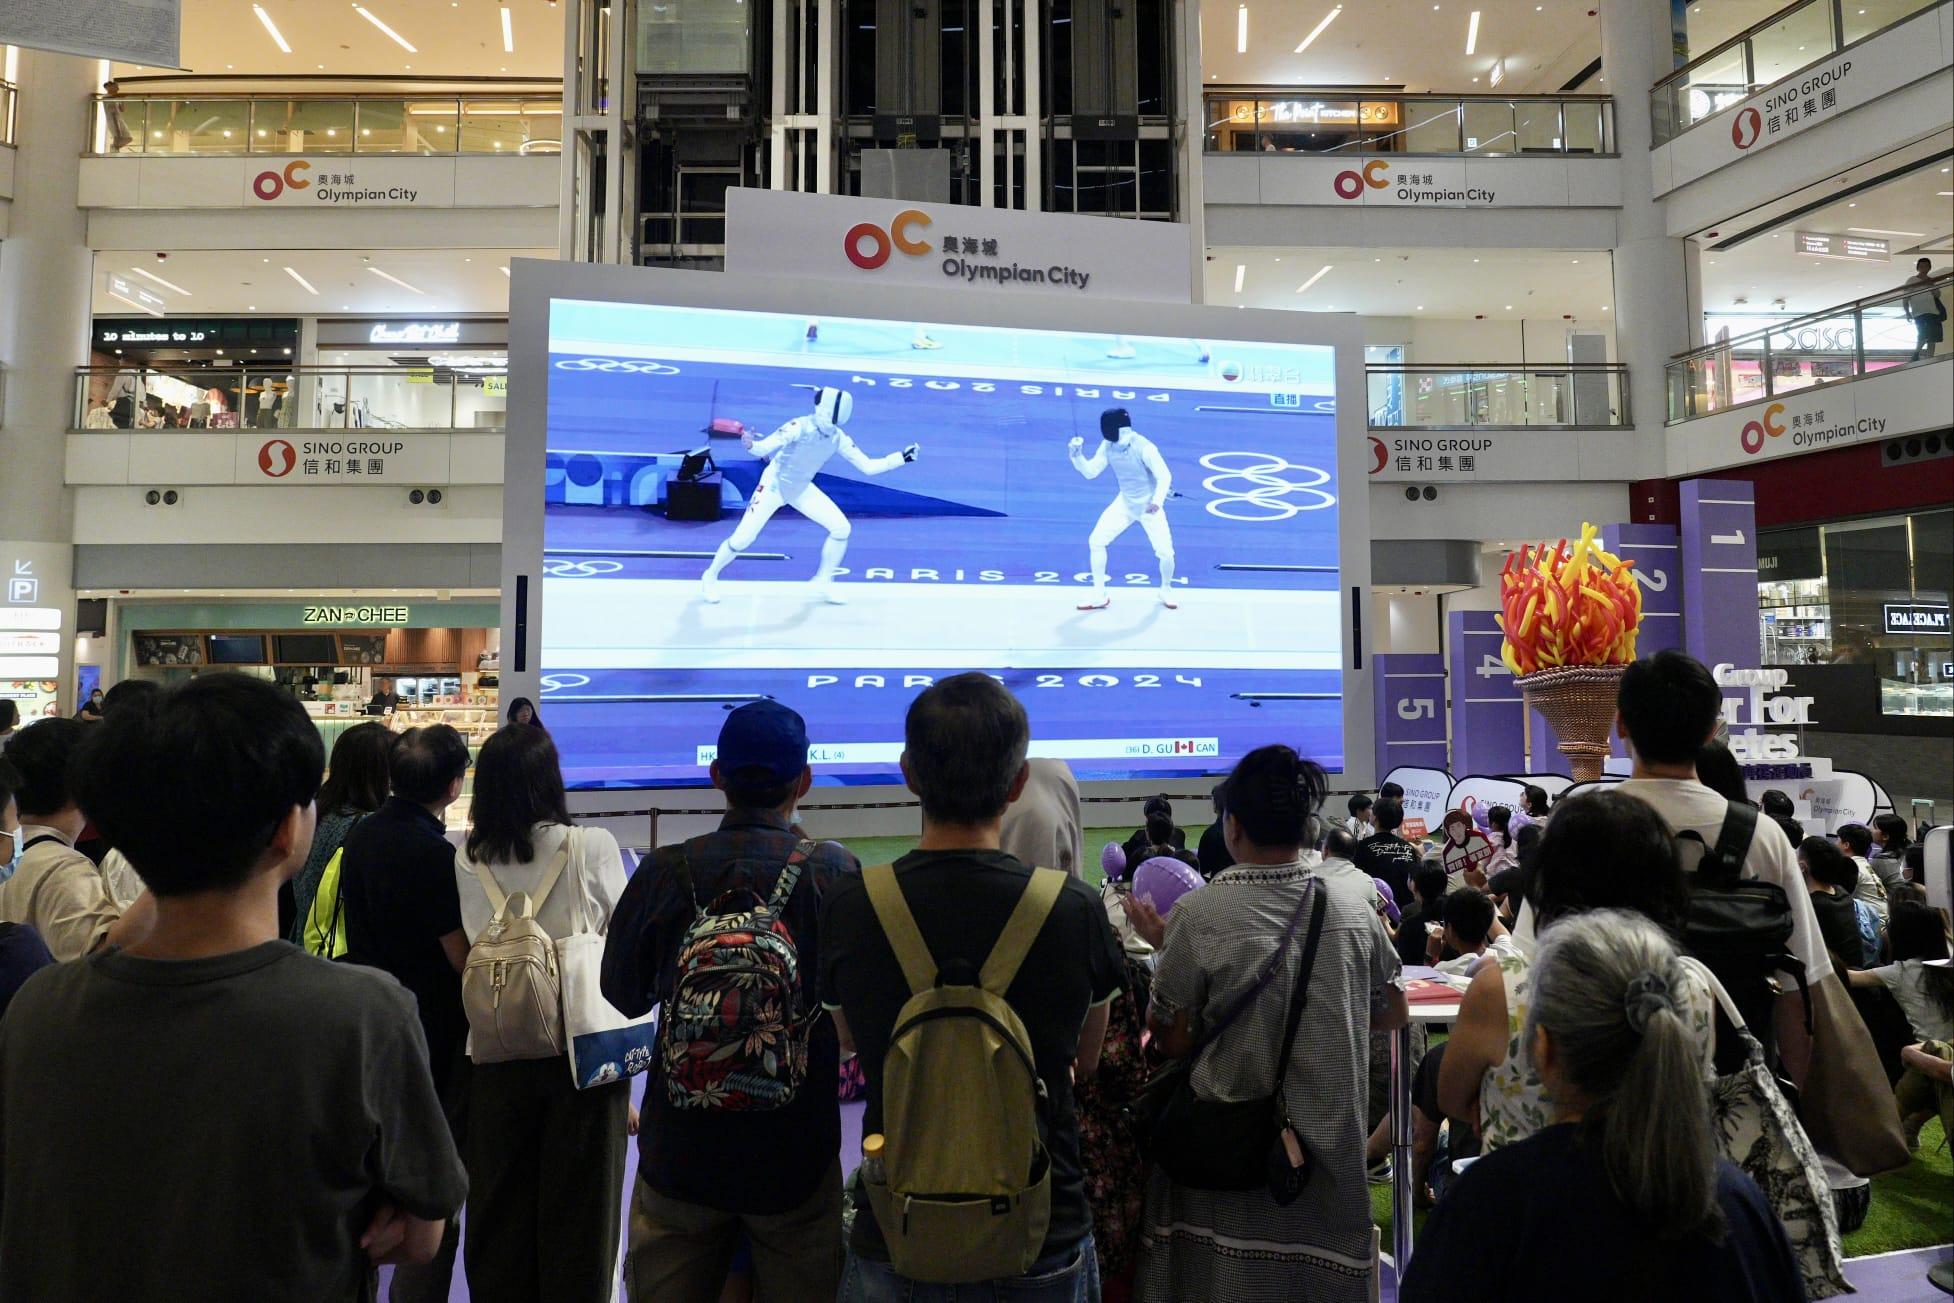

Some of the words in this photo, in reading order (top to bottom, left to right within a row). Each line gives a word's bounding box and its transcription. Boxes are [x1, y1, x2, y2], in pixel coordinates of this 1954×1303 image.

[1765, 88, 1798, 113] SINO
[1801, 61, 1852, 95] GROUP
[1767, 88, 1836, 135] 信和集團
[317, 188, 386, 202] Olympian
[388, 187, 418, 202] City
[1397, 188, 1465, 203] Olympian
[1467, 188, 1496, 203] City
[942, 258, 1045, 284] Olympian
[1047, 265, 1090, 290] City
[103, 331, 118, 341] 10
[122, 330, 169, 341] minutes
[172, 331, 186, 341] to
[190, 331, 205, 341] 10
[1274, 393, 1297, 405] 直播
[1792, 424, 1855, 446] Olympian
[1857, 418, 1887, 433] City
[303, 442, 342, 454] SINO
[347, 442, 404, 454] GROUP
[1395, 439, 1433, 451] SINO
[1437, 439, 1493, 451] GROUP
[303, 458, 384, 475] 信和集團
[1395, 455, 1475, 472] 信和集團
[1758, 556, 1777, 569] MUJI
[304, 608, 342, 622] ZAN
[357, 608, 407, 623] CHEE
[1712, 663, 1788, 692] Group
[1156, 743, 1173, 754] GU
[1196, 743, 1216, 753] CAN
[1728, 728, 1799, 760] etes
